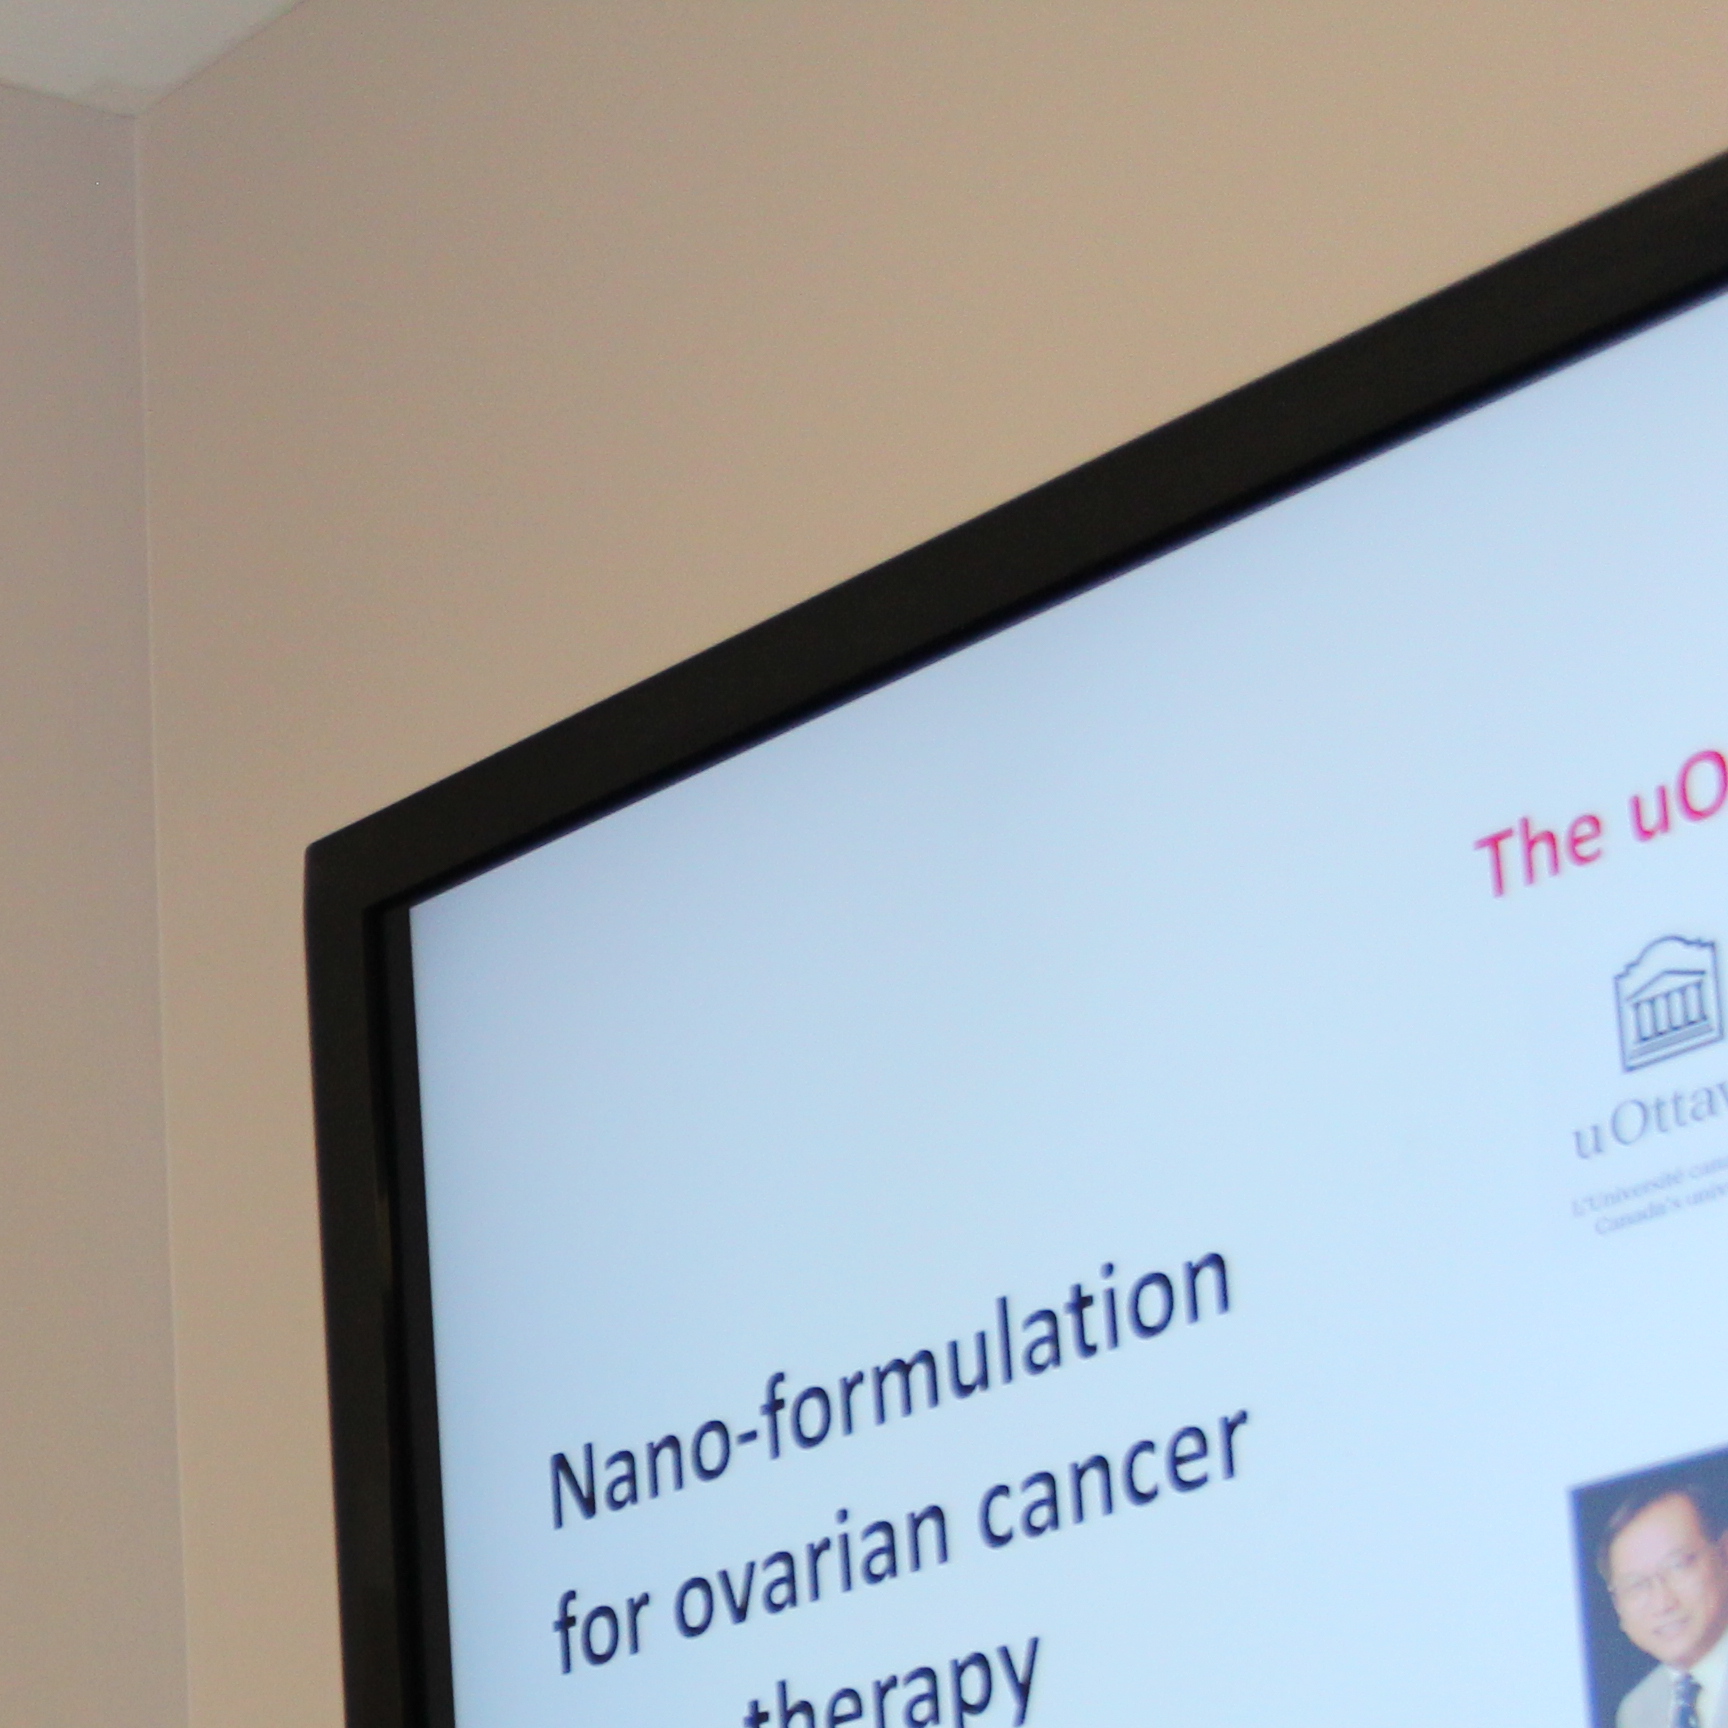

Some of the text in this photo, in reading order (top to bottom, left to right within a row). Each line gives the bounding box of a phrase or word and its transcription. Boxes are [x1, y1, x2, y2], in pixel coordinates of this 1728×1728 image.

[1474, 811, 1605, 899] The
[548, 1249, 1232, 1530] Nano-formulation
[552, 1407, 1250, 1677] for ovarian cancer
